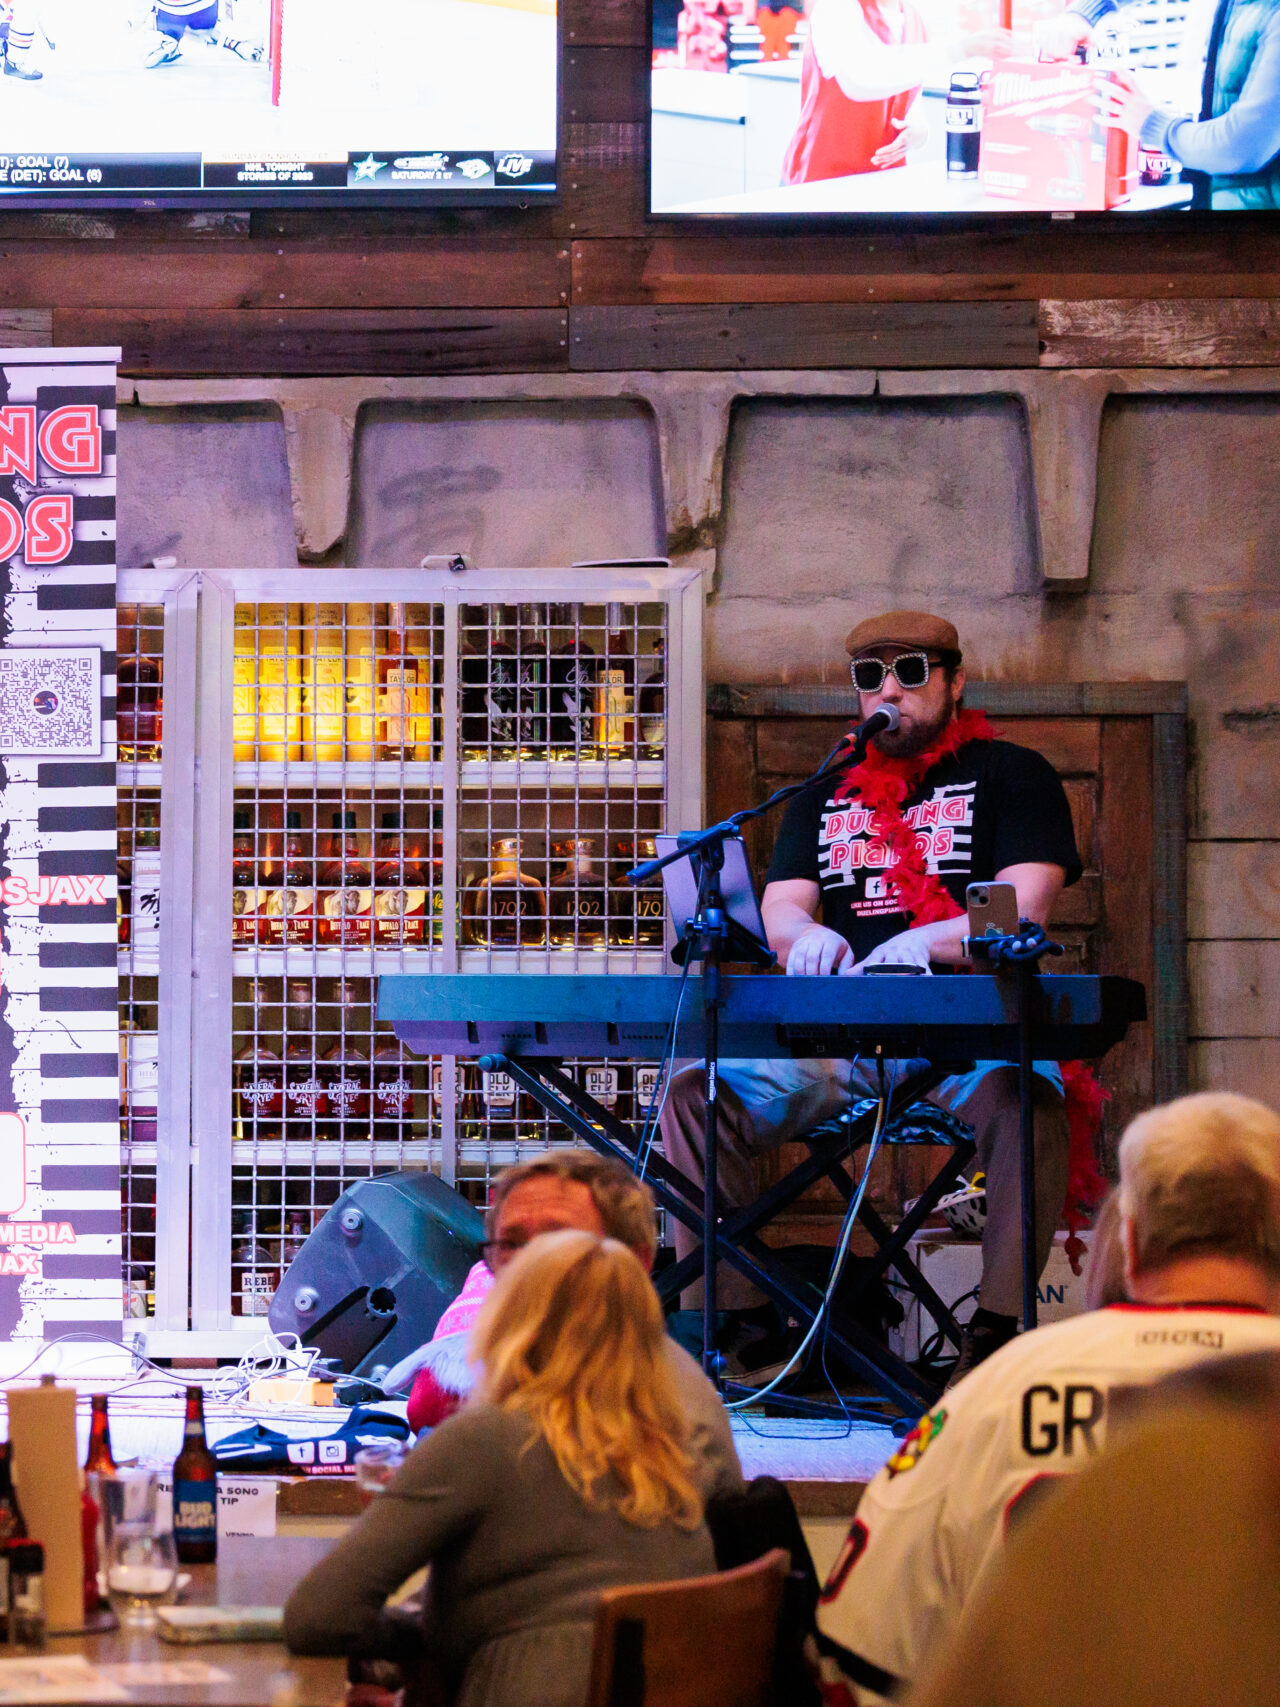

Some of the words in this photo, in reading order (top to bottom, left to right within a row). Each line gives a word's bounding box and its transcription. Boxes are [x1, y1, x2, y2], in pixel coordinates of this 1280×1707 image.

[17, 156, 51, 168] GOAL
[54, 155, 69, 168] (7)
[496, 158, 533, 173] LIVE
[245, 163, 264, 172] NHL
[265, 163, 306, 171] TONIGHT
[11, 169, 47, 183] (DET):
[50, 169, 84, 181] GOAL
[237, 172, 276, 181] STORIES
[278, 172, 291, 180] OF
[392, 171, 435, 179] SATURDAY
[826, 798, 966, 839] DUEING
[638, 901, 662, 917] 179
[293, 919, 309, 930] TRACE
[489, 1074, 510, 1084] OLD
[591, 1073, 612, 1084] OLD
[312, 1465, 343, 1474] SOCIAL
[221, 1497, 239, 1505] TIP
